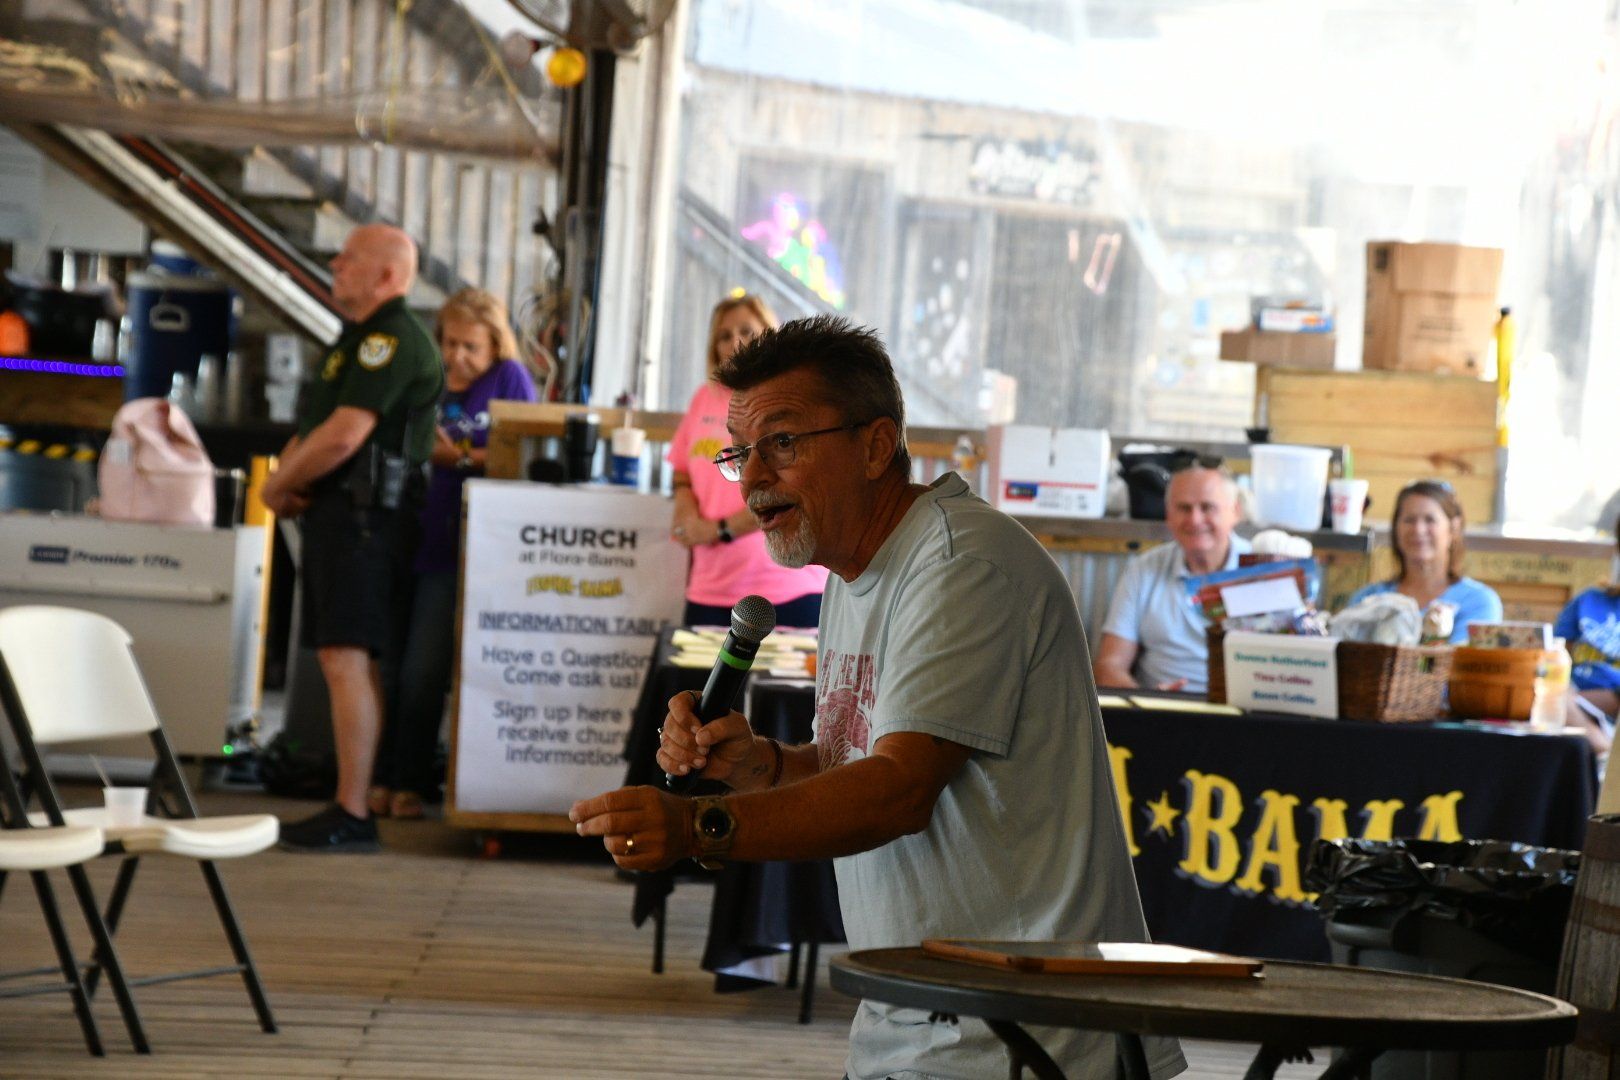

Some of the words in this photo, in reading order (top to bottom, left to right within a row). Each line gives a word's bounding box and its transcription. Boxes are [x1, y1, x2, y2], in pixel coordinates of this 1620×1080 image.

[519, 525, 637, 548] CHURCH
[479, 611, 608, 633] INFORMATION
[482, 646, 533, 665] Have
[541, 650, 554, 665] a
[504, 667, 560, 686] Come
[568, 669, 602, 687] ask
[493, 700, 536, 722] Sign
[543, 705, 570, 724] up
[577, 704, 623, 722] here
[497, 724, 569, 743] receive
